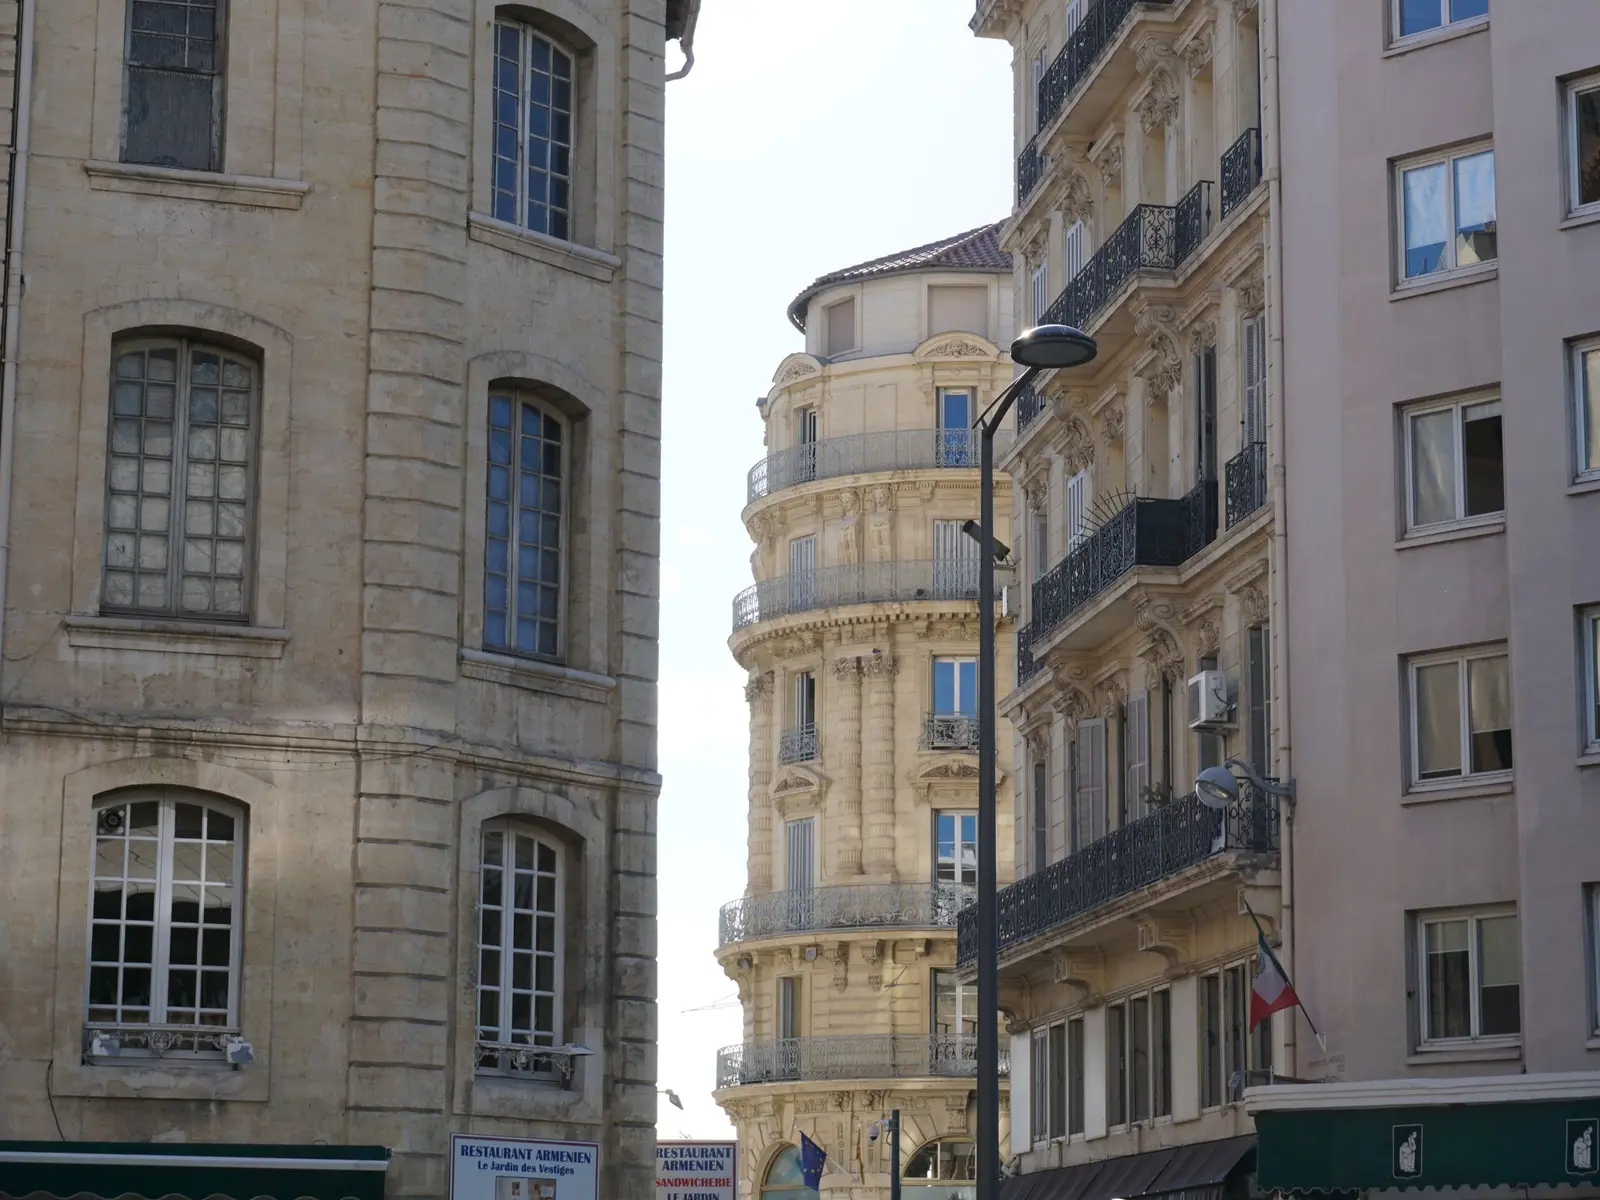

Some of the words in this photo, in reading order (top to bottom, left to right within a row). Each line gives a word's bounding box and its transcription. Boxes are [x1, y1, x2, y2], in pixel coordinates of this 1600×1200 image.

[460, 1145, 533, 1160] RESTAURANT
[536, 1150, 592, 1164] ARMENIEN
[656, 1147, 732, 1158] RESTAURANT
[478, 1161, 489, 1170] Le
[491, 1161, 519, 1172] Jardin
[521, 1163, 537, 1173] des
[539, 1165, 575, 1176] Vestiges
[662, 1160, 724, 1171] ARMENIEN
[656, 1178, 732, 1188] SANDWICHERIE
